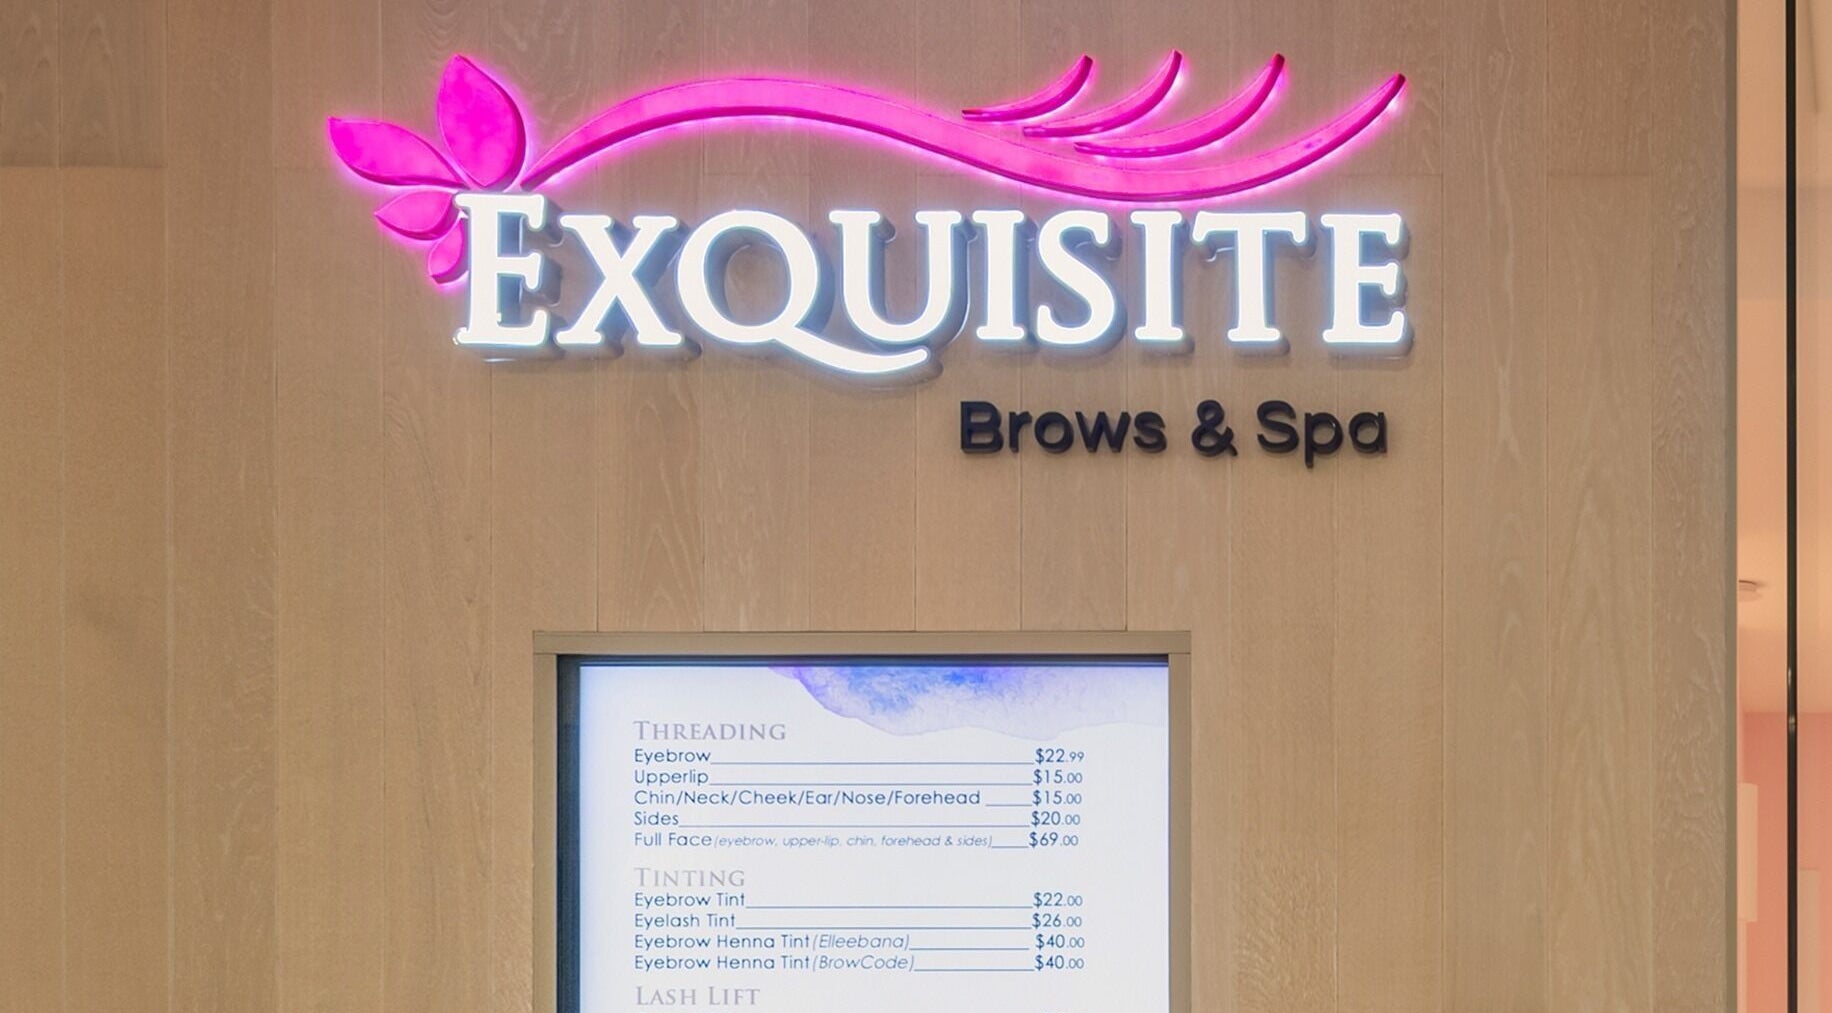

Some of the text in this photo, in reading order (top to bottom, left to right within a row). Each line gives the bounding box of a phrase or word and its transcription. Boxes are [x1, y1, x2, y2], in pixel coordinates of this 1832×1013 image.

[958, 399, 1389, 467] Brows & Spa
[633, 721, 786, 740] THREADING
[635, 748, 1084, 765] Eyebrow $22.99
[635, 769, 1083, 786] Upperlip $15.00
[634, 789, 1082, 807] Chin/Neck/Cheek/Ear/Nose/Forehead $15.00
[634, 810, 1081, 828] Sides $20.00
[635, 832, 661, 846] Full
[881, 835, 940, 846] forehead
[944, 836, 953, 846] &
[957, 836, 992, 848] sides)
[1029, 831, 1079, 849] $69.00
[634, 868, 744, 886] TINTING
[635, 891, 1083, 909] Eyebrow Tint $22.00
[635, 912, 1082, 930] Eyelash Tint $26.00
[635, 934, 711, 951] Eyebrow
[717, 935, 775, 948] Henna
[1035, 933, 1085, 951] $40.00
[635, 955, 711, 972] Eyebrow
[717, 956, 775, 969] Henna
[1034, 954, 1084, 972] $40.00
[636, 986, 760, 1005] LASH LIFT
